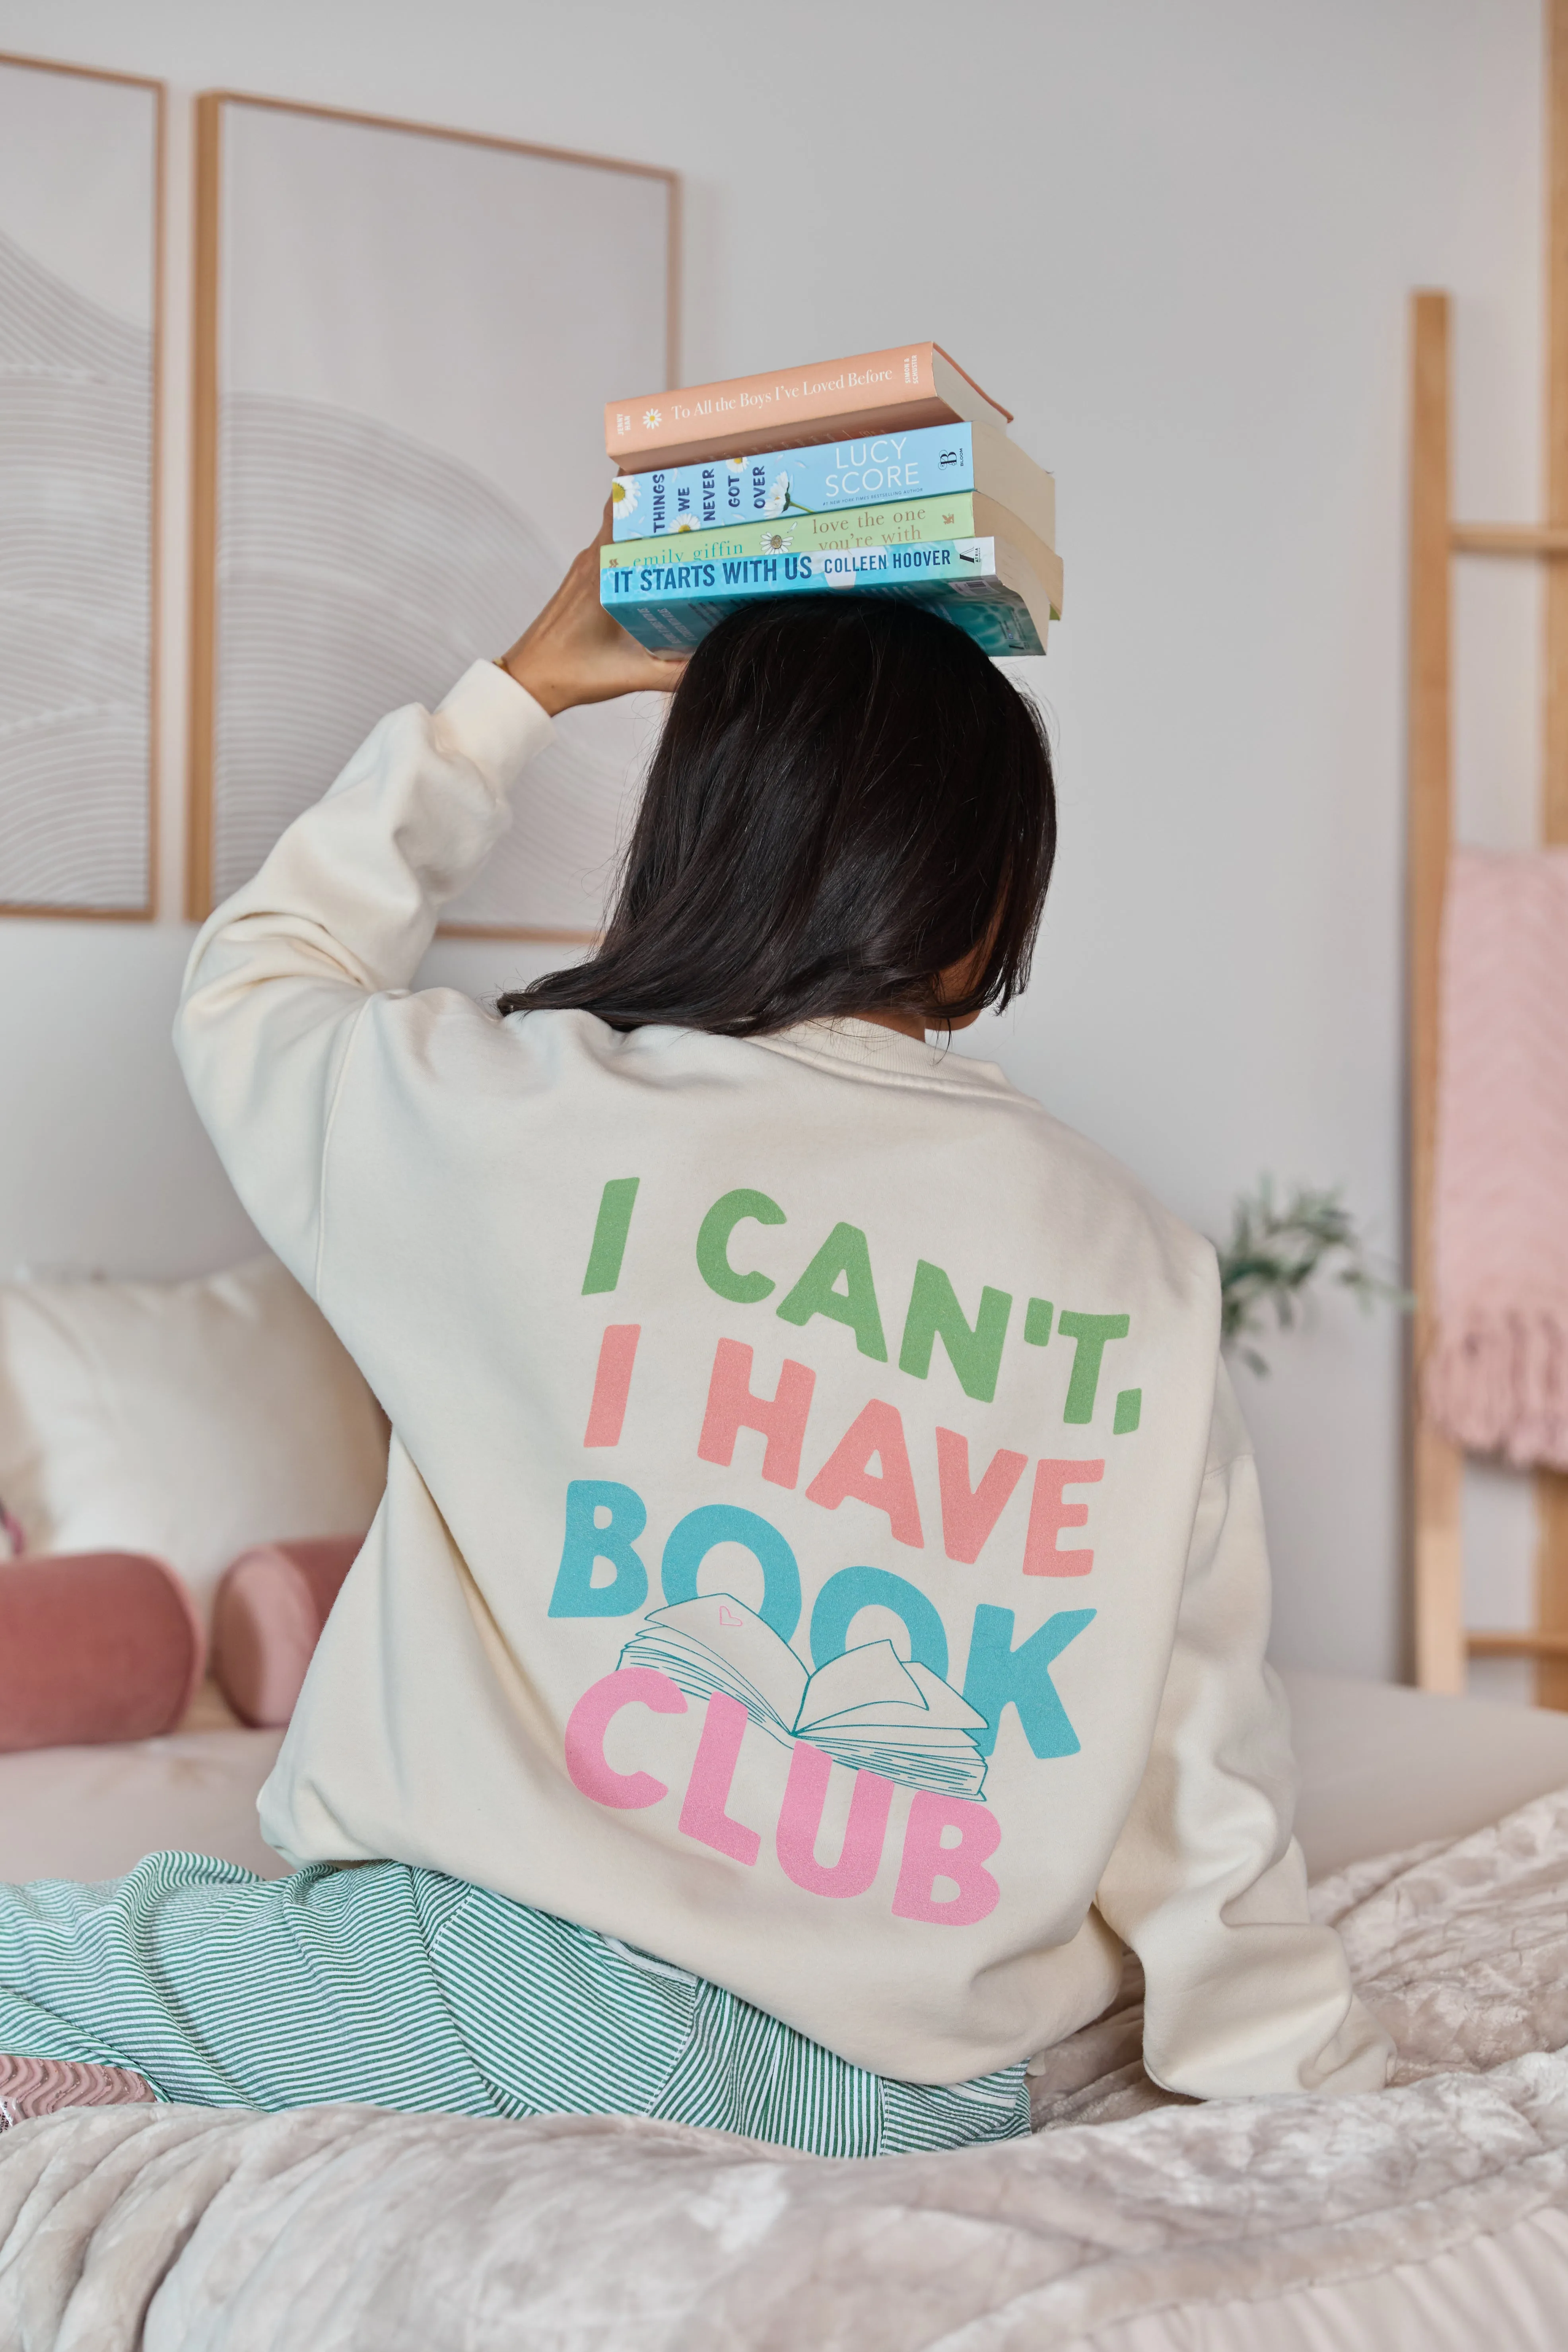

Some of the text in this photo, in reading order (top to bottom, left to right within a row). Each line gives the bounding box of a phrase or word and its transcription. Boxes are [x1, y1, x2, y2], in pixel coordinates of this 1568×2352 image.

[671, 369, 893, 420] To All the Boys I've Loved Before
[836, 437, 907, 469] LUCY
[702, 468, 715, 521] NEVER
[728, 475, 740, 507] GOT
[752, 465, 766, 509] OVER
[826, 462, 919, 497] SCORE
[653, 473, 665, 533] THINGS
[678, 487, 690, 512] WE
[812, 509, 926, 534] love the one
[881, 525, 922, 544] with
[693, 540, 743, 561] giffin
[824, 550, 951, 574] COLLEEN HOOVER
[614, 556, 812, 593] IT STARTS WITH US
[581, 1177, 640, 1295] I
[583, 1324, 1104, 1577] I HAVE
[547, 1479, 1098, 1760] BOOK
[564, 1666, 1002, 1927] CLUB
